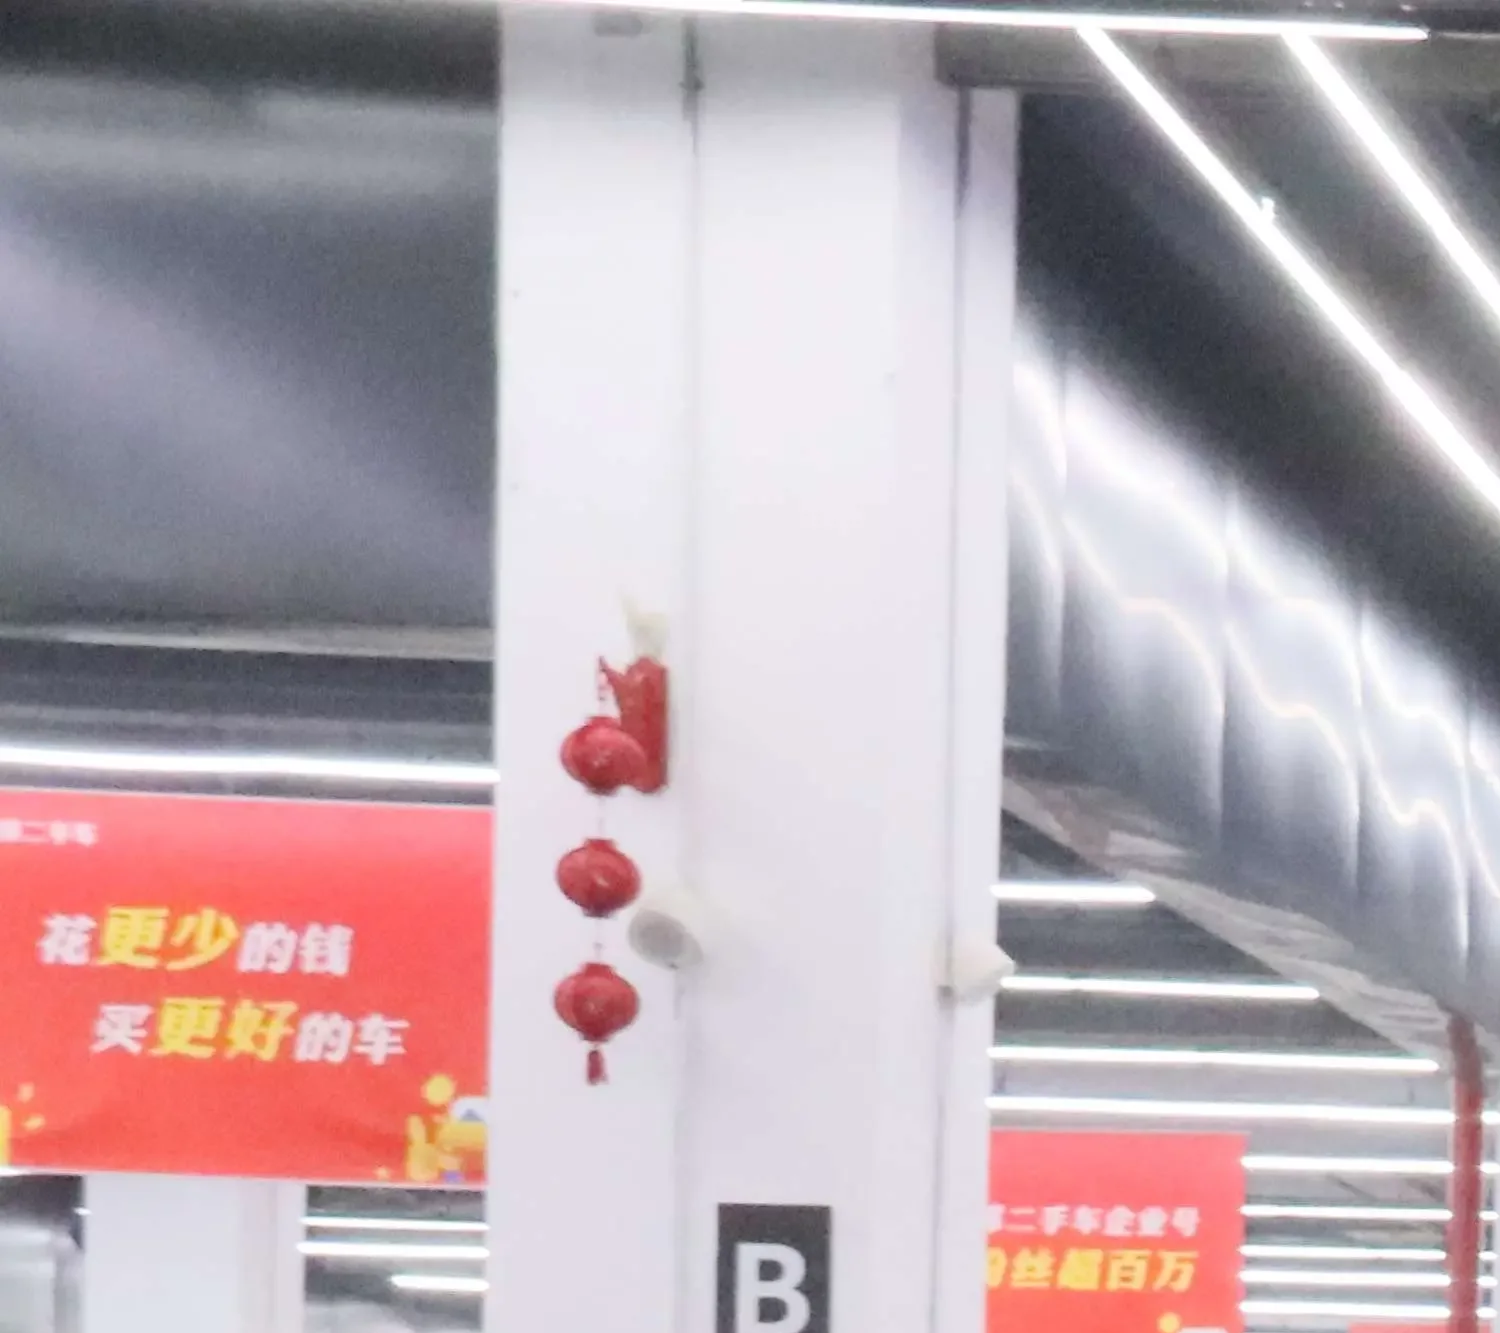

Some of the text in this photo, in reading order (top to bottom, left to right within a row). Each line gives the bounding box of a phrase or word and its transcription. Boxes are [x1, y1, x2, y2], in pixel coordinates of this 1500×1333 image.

[37, 905, 354, 976] 花更少的钱
[90, 997, 409, 1066] 买更好的车
